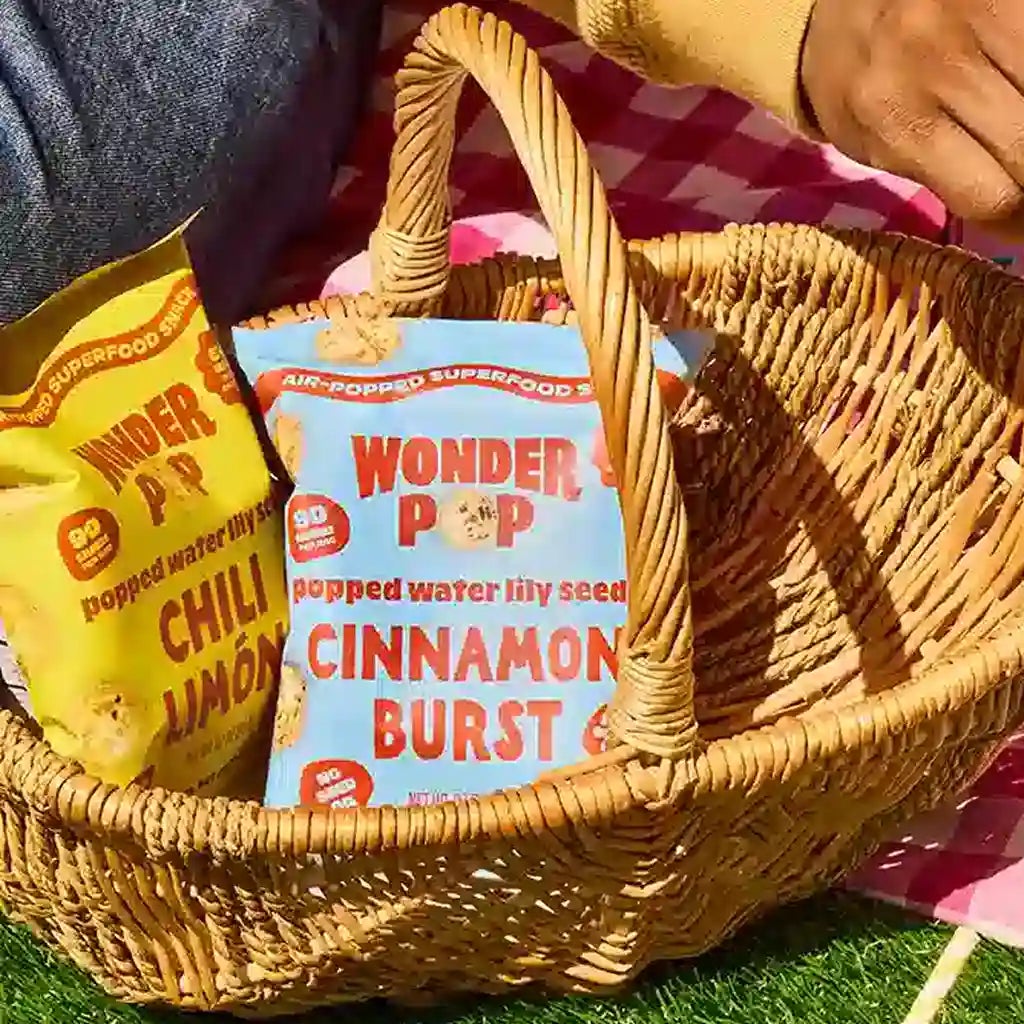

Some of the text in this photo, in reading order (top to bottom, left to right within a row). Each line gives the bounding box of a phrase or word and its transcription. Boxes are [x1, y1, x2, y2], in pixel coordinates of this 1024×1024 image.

[48, 330, 161, 394] SUPERFOOD
[282, 373, 425, 397] AIR-POPPED
[429, 367, 571, 397] SUPERFOOD
[350, 433, 583, 501] WONDER
[80, 557, 166, 623] popped
[167, 525, 226, 576] water
[226, 508, 257, 543] lily
[292, 575, 628, 607] popped water lily seed
[159, 552, 269, 663] CHILI
[163, 620, 284, 746] LIMÓN
[307, 622, 624, 683] CINNAMON
[373, 698, 564, 762] BURST
